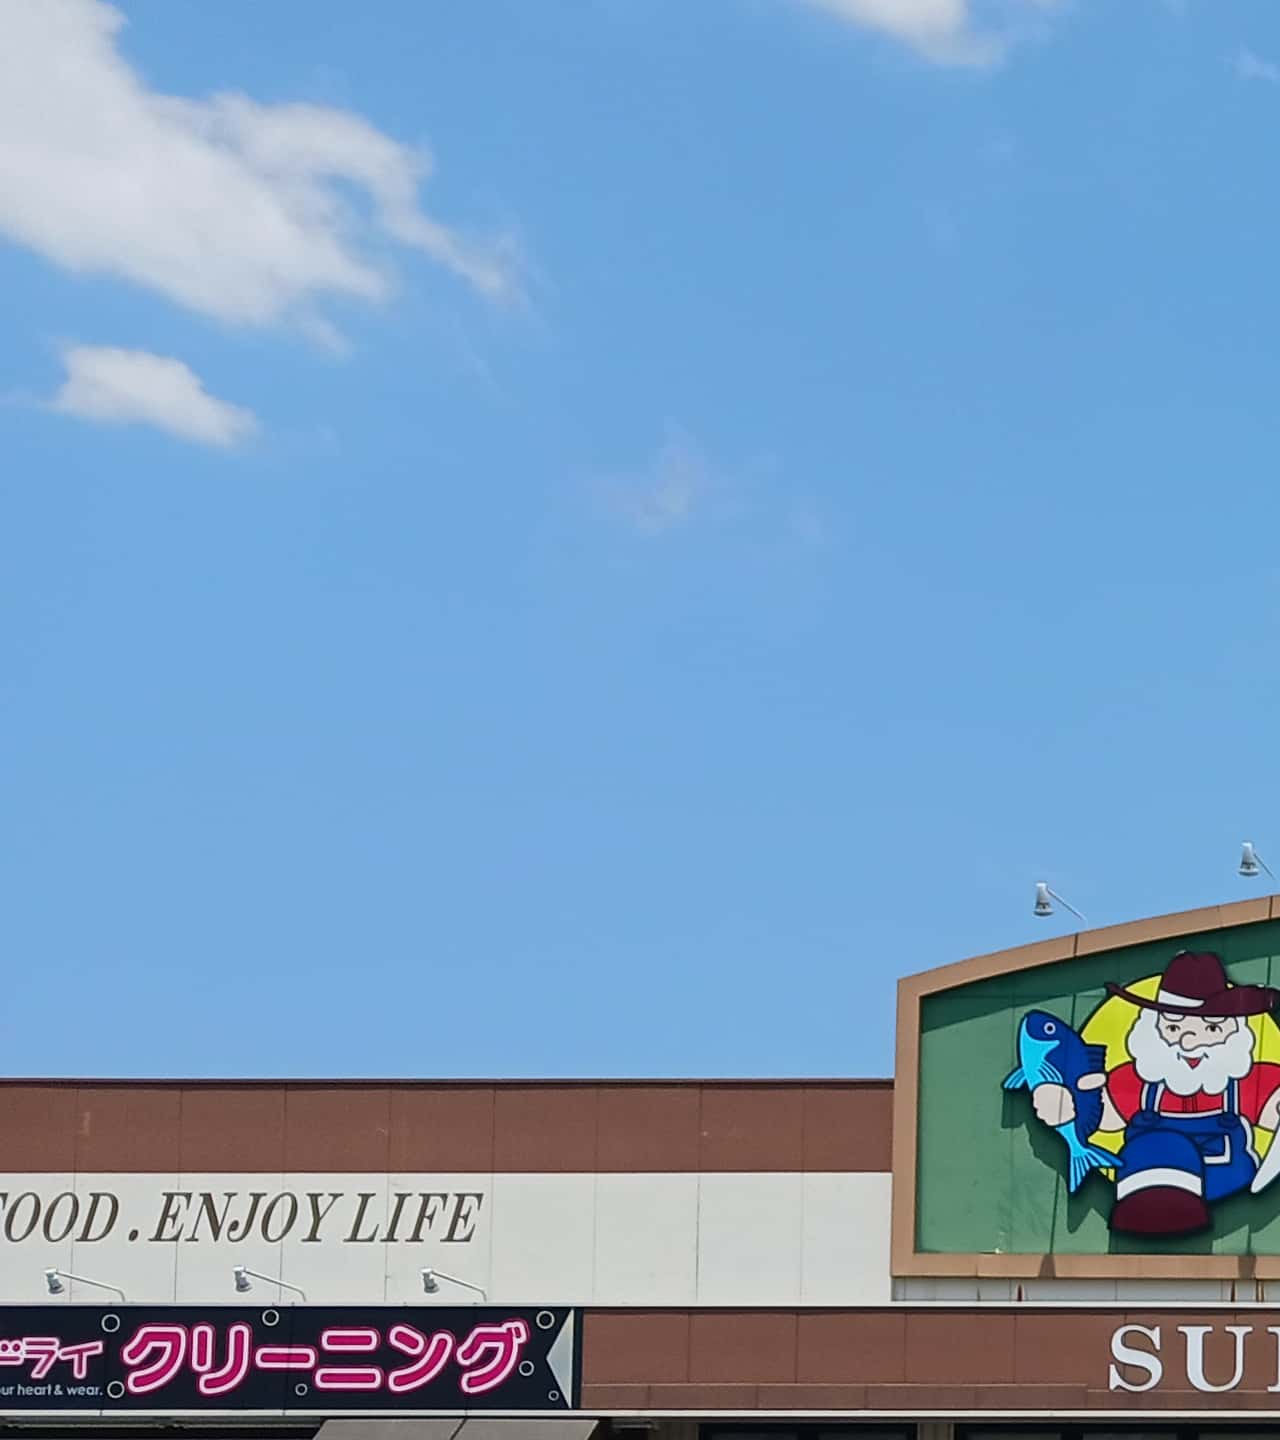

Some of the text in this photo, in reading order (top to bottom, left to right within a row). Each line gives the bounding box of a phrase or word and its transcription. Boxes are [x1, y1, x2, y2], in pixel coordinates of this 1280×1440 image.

[148, 1192, 344, 1243] ENJOY
[343, 1192, 483, 1243] LIFE
[122, 1318, 530, 1394] クリーニング
[17, 1384, 52, 1396] heart
[54, 1384, 63, 1396] &
[67, 1385, 103, 1396] wear.
